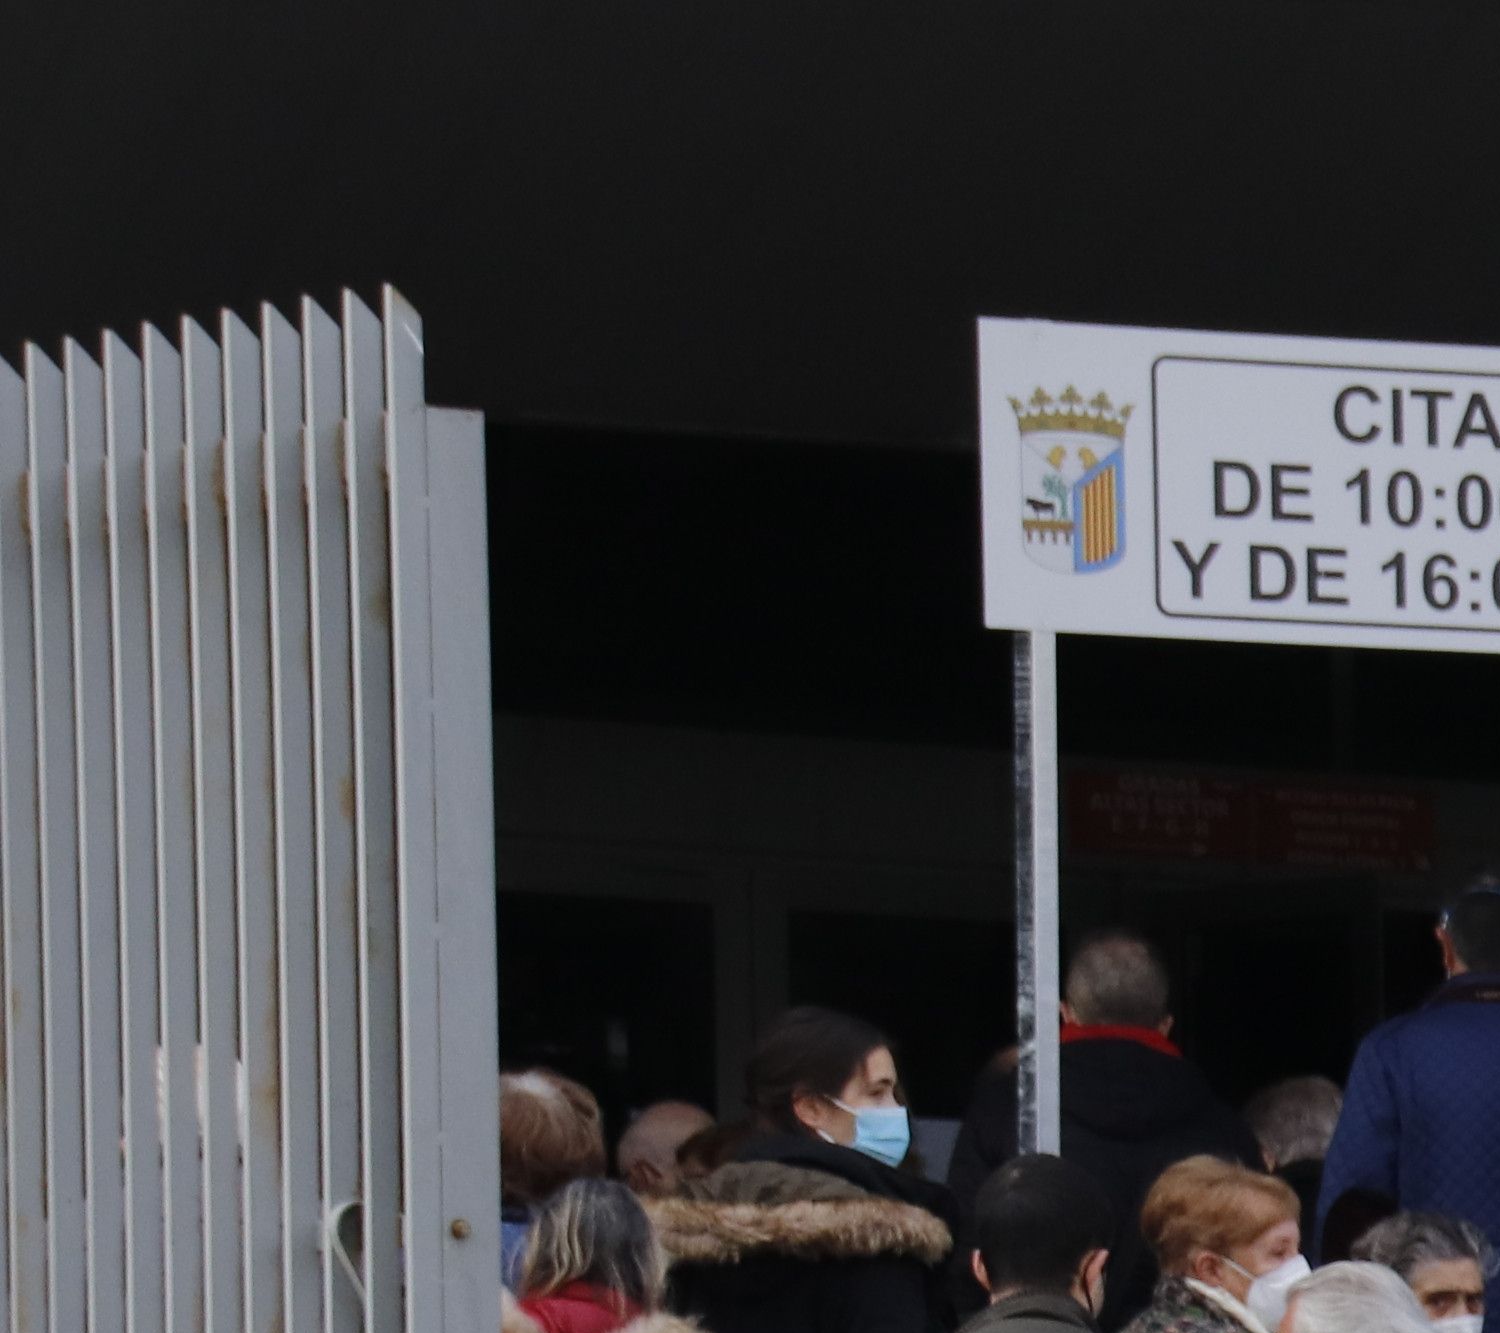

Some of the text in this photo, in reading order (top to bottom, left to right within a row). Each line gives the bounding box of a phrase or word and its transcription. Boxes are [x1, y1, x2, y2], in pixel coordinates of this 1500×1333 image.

[1213, 460, 1314, 522] DE
[1171, 539, 1221, 600] Y
[1249, 544, 1350, 606] DE
